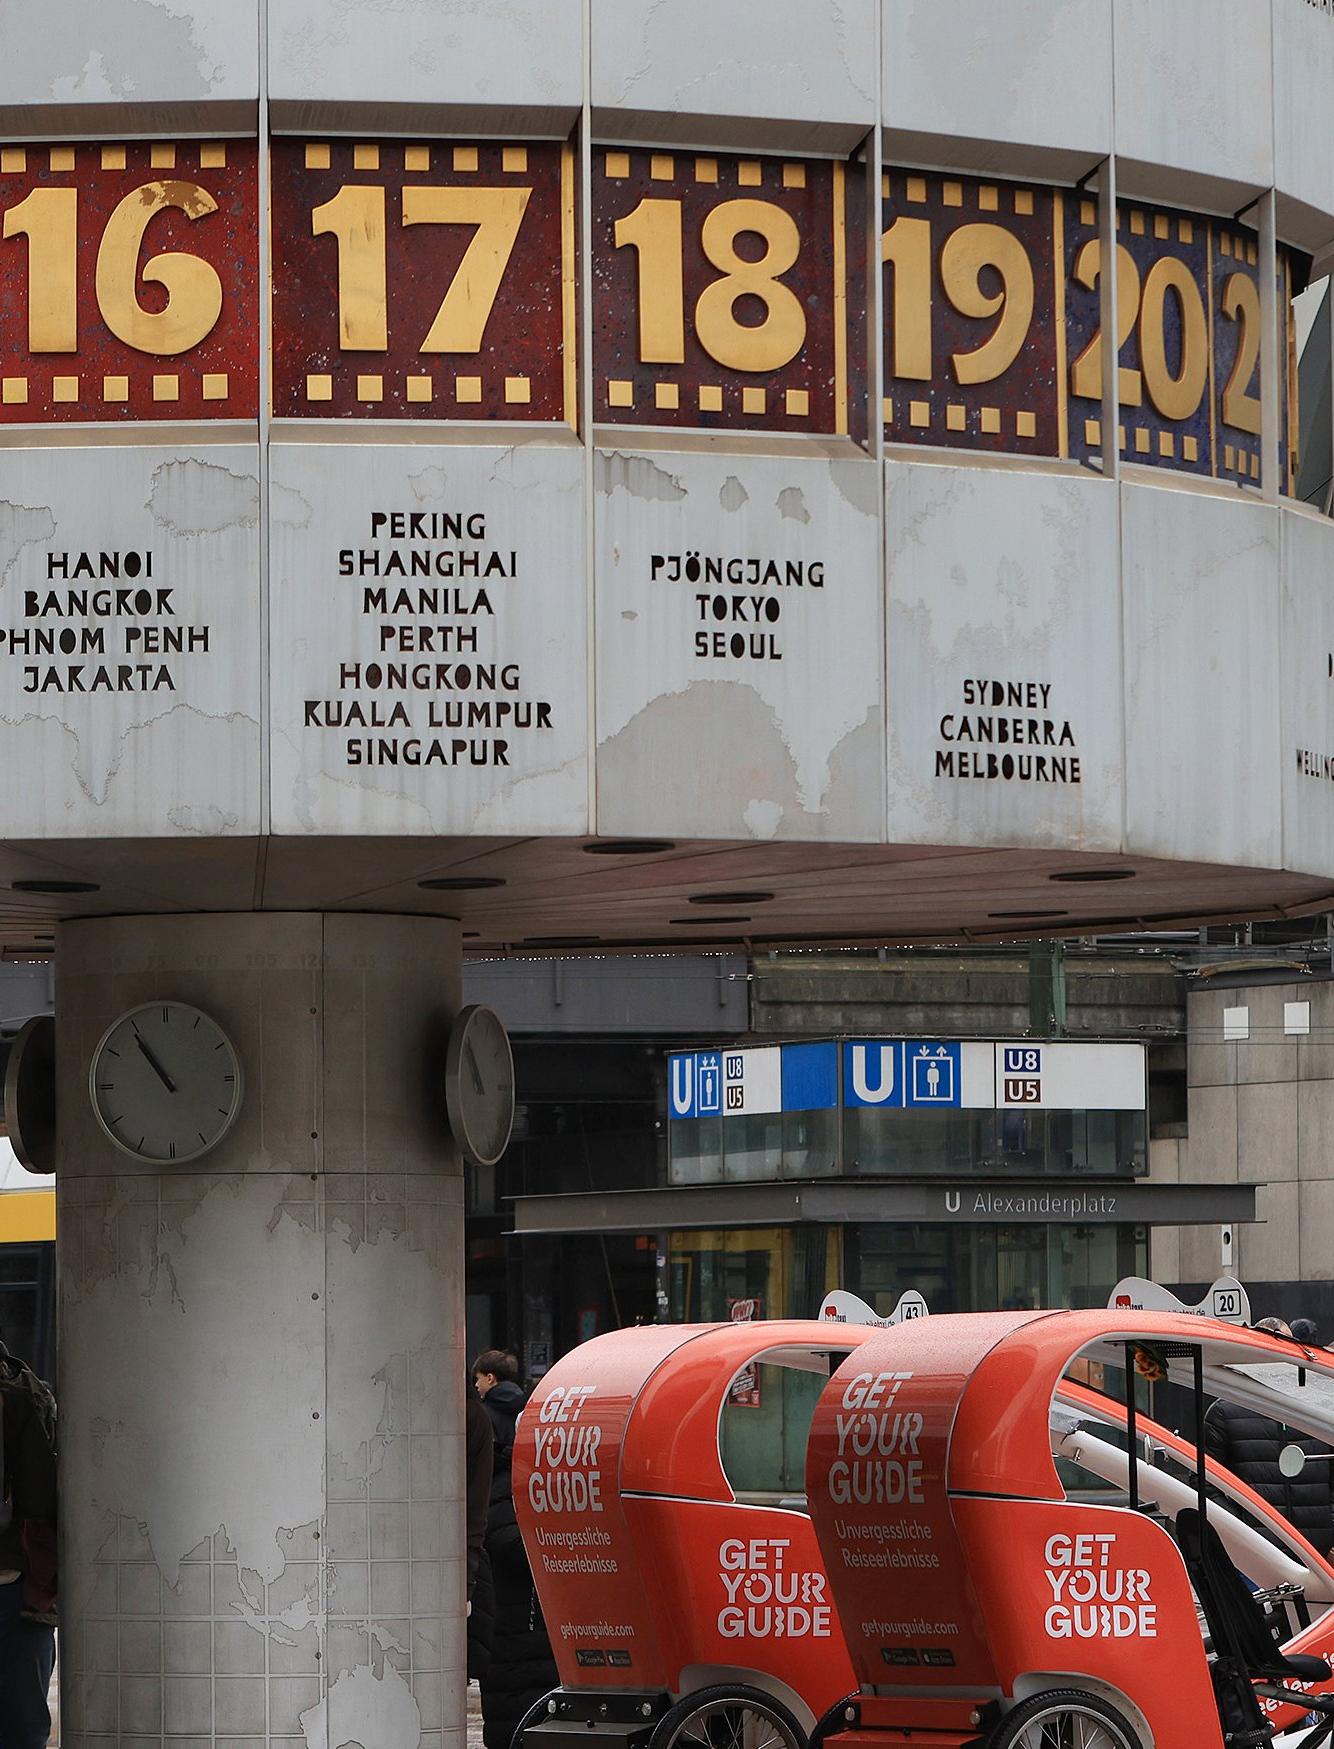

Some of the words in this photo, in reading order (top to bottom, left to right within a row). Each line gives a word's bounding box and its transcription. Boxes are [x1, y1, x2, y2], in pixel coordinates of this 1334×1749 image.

[3, 180, 223, 355] 16
[313, 186, 533, 353] 17
[615, 198, 806, 372] 18
[882, 216, 1034, 385] 19
[1072, 238, 1208, 420] 20
[371, 512, 485, 540] PEKING
[47, 551, 152, 579] HANOI
[339, 550, 516, 577] SHANGHAI
[651, 551, 824, 588] PJÖNGJANG
[24, 589, 175, 617] BANGKOK
[363, 587, 494, 615] MANILA
[696, 594, 780, 623] TOKYO
[125, 626, 209, 653] PENH
[380, 625, 477, 652] PERTH
[695, 632, 782, 660] SEOUL
[23, 665, 176, 692] JAKARTA
[340, 663, 520, 690] HONGKONG
[964, 679, 1051, 709] SYDNEY
[304, 701, 411, 727] KUALA
[429, 701, 553, 728] LUMPUR
[940, 715, 1075, 746] CANBERRA
[347, 739, 510, 766] SINGAPUR
[935, 751, 1080, 783] MELBOURNE
[728, 1058, 742, 1078] U8
[853, 1045, 894, 1103] U
[1008, 1050, 1037, 1071] U8
[672, 1058, 692, 1114] U
[728, 1087, 742, 1108] U5
[1008, 1080, 1037, 1101] U5
[945, 1192, 960, 1213] U
[973, 1192, 1116, 1215] Alexanderplatz
[906, 1306, 920, 1320] 43
[1219, 1294, 1235, 1312] 20
[539, 1386, 597, 1423] GET
[842, 1372, 914, 1410] GET
[534, 1426, 601, 1468] YOUR
[836, 1413, 923, 1456] YOUR
[528, 1471, 603, 1512] GUIDE
[829, 1461, 924, 1504] GUIDE
[535, 1527, 611, 1550] Unvergessliche
[834, 1520, 932, 1544] Unvergessliche
[542, 1554, 618, 1574] Reiseerlebnisse
[719, 1539, 790, 1570] GET
[842, 1548, 939, 1569] Reiseerlebnisse
[1045, 1534, 1115, 1567] GET
[719, 1572, 827, 1604] YOUR
[1045, 1569, 1151, 1602] YOUR
[561, 1622, 635, 1640] getyourguide.com
[717, 1606, 831, 1638] GUIDE
[862, 1619, 959, 1640] getyourguide.com
[1045, 1605, 1157, 1638] GUIDE
